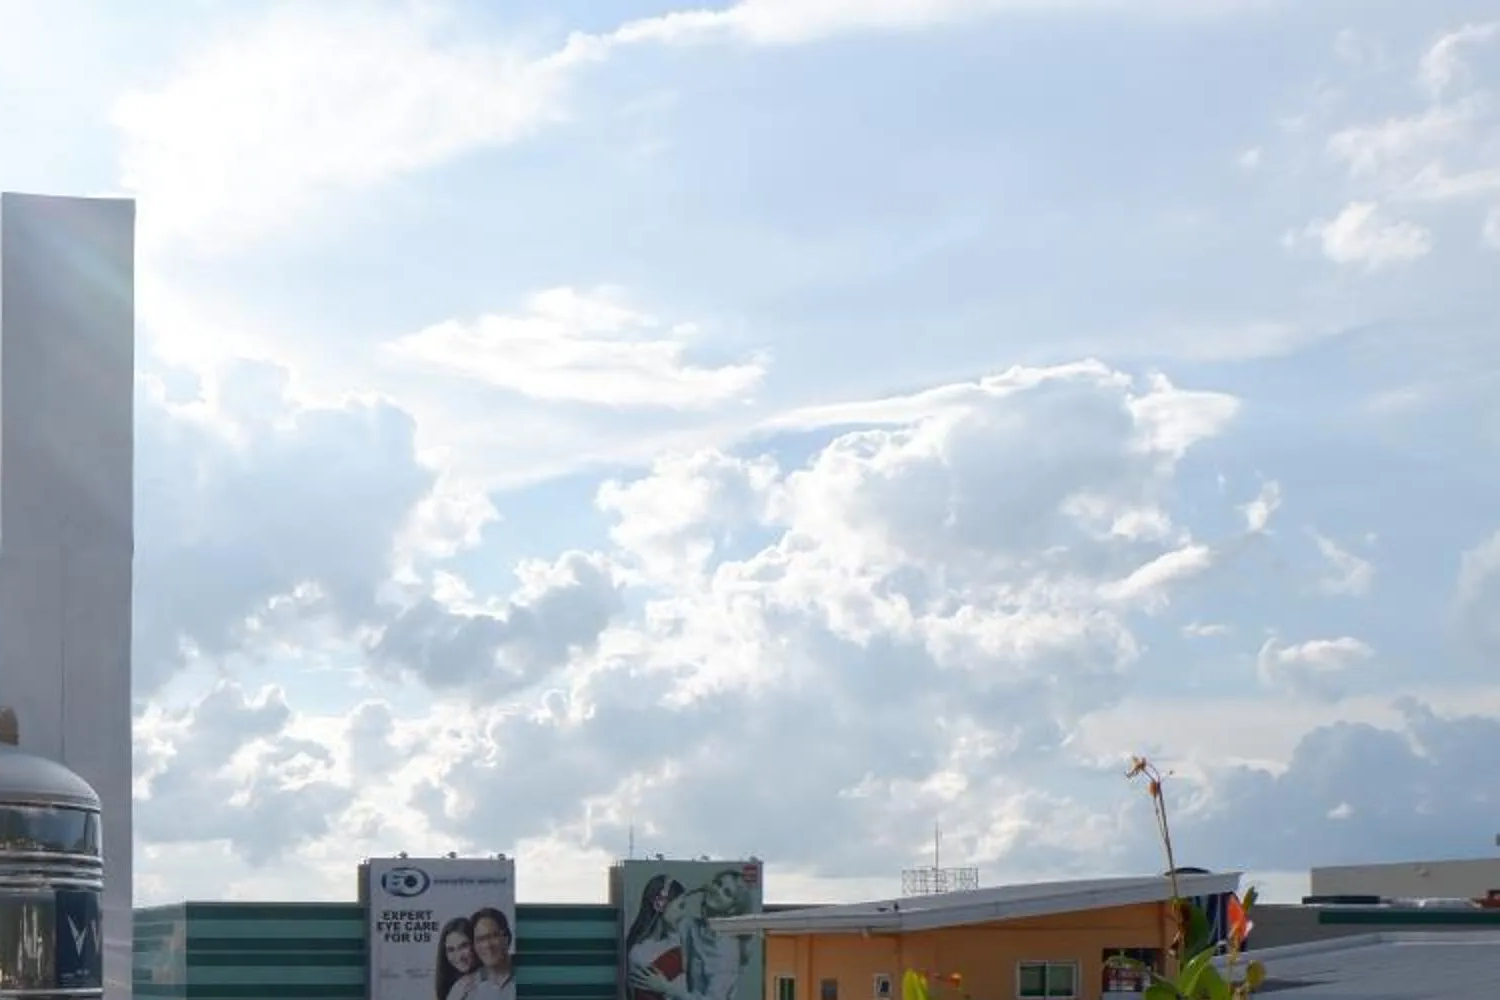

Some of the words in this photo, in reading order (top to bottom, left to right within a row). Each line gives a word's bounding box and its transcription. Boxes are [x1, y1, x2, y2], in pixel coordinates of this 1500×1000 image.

[382, 910, 434, 921] EXPERT
[377, 921, 402, 931] EYE
[404, 921, 439, 932] CARE
[384, 932, 411, 942] FOR
[414, 932, 432, 943] US
